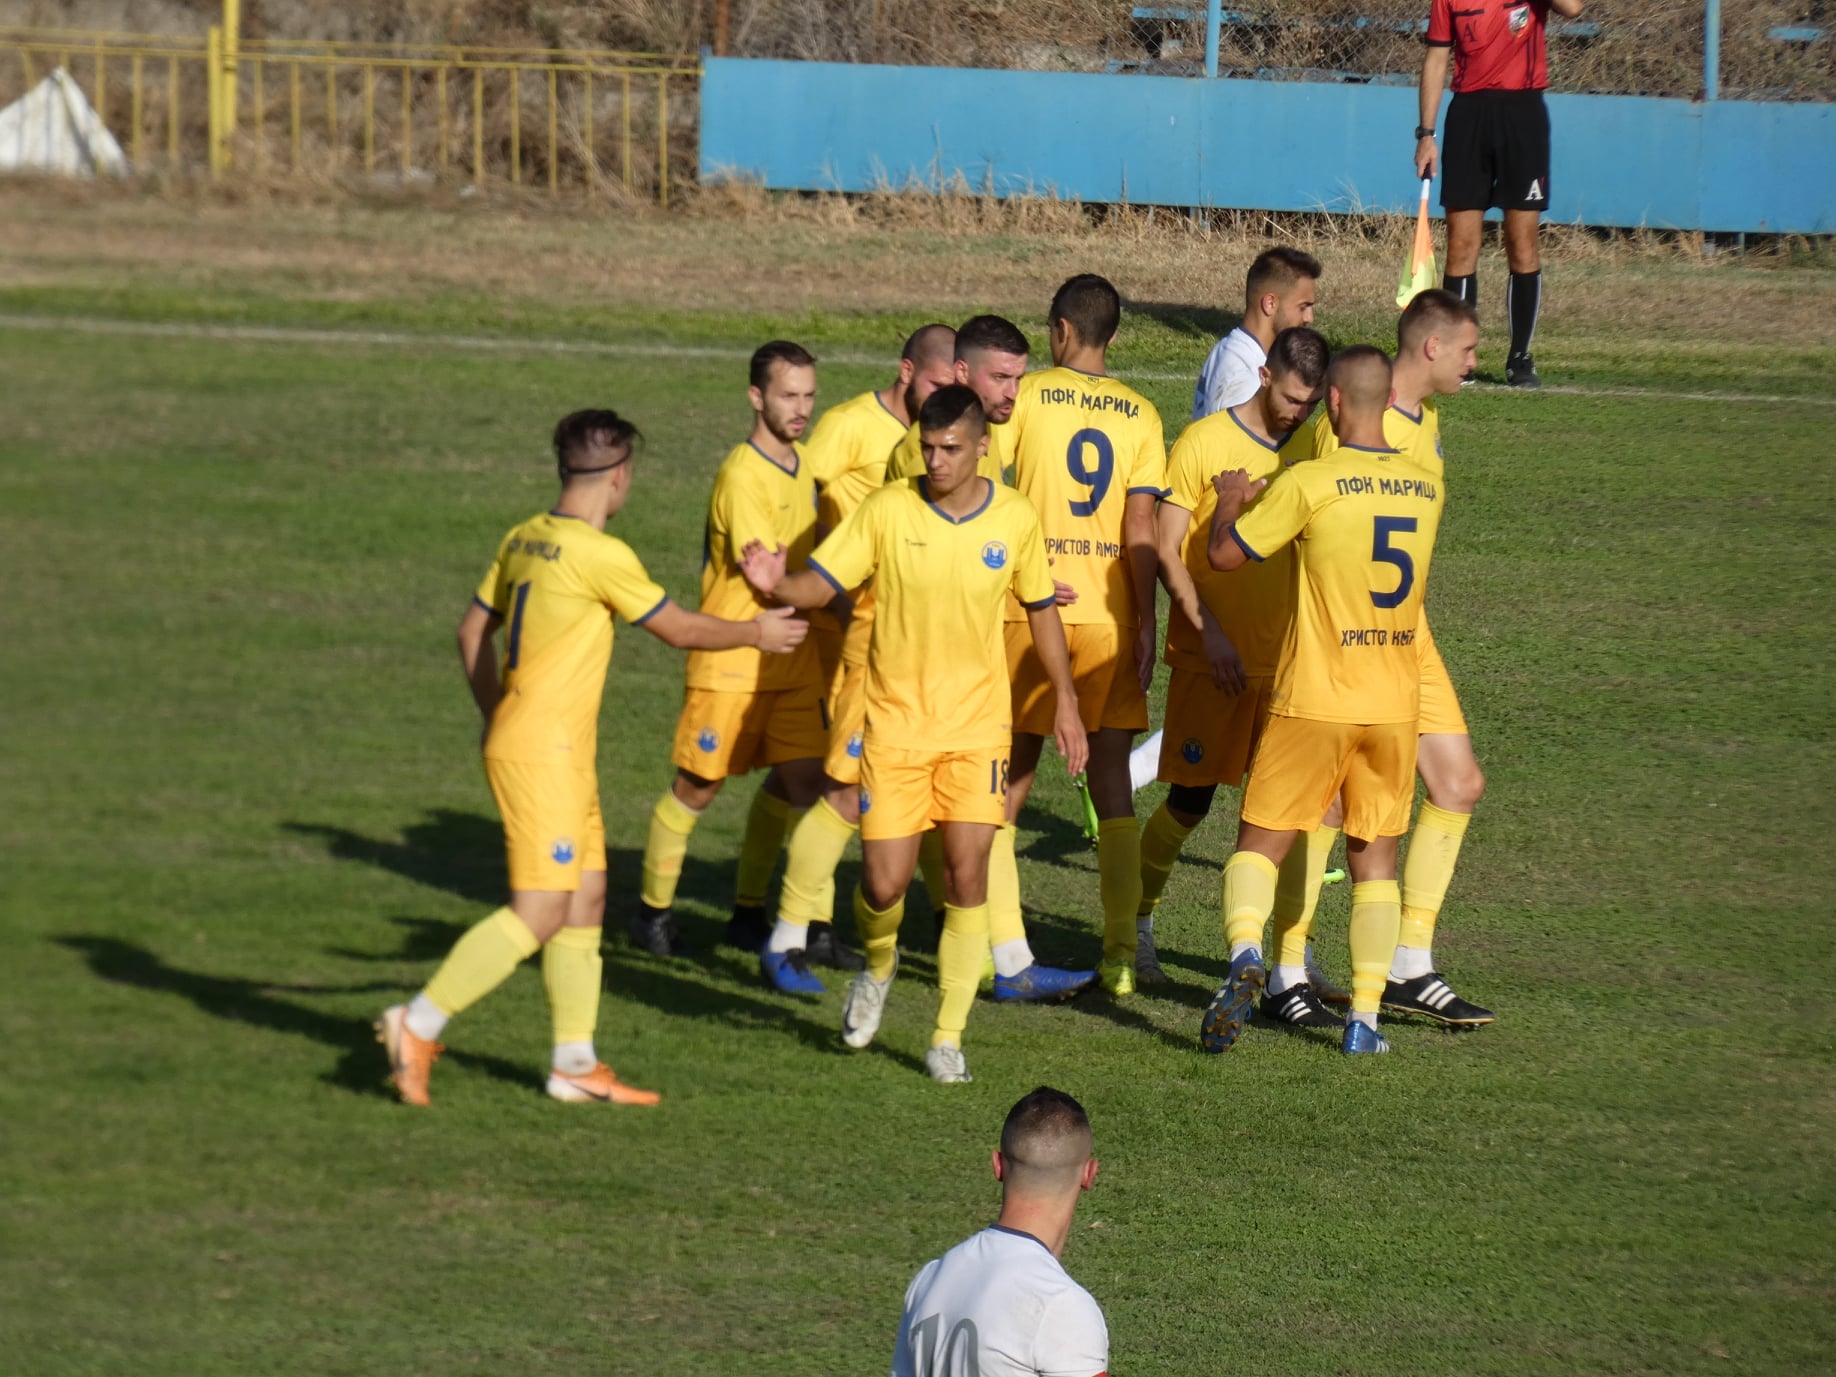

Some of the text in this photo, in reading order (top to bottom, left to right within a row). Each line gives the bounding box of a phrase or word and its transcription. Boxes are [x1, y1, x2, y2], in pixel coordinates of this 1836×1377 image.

[1041, 388, 1139, 419] ПФК МАРИЦА
[1066, 428, 1114, 517] 9
[1336, 476, 1374, 496] ПФК
[1369, 515, 1418, 609] 5
[989, 758, 1009, 796] 18
